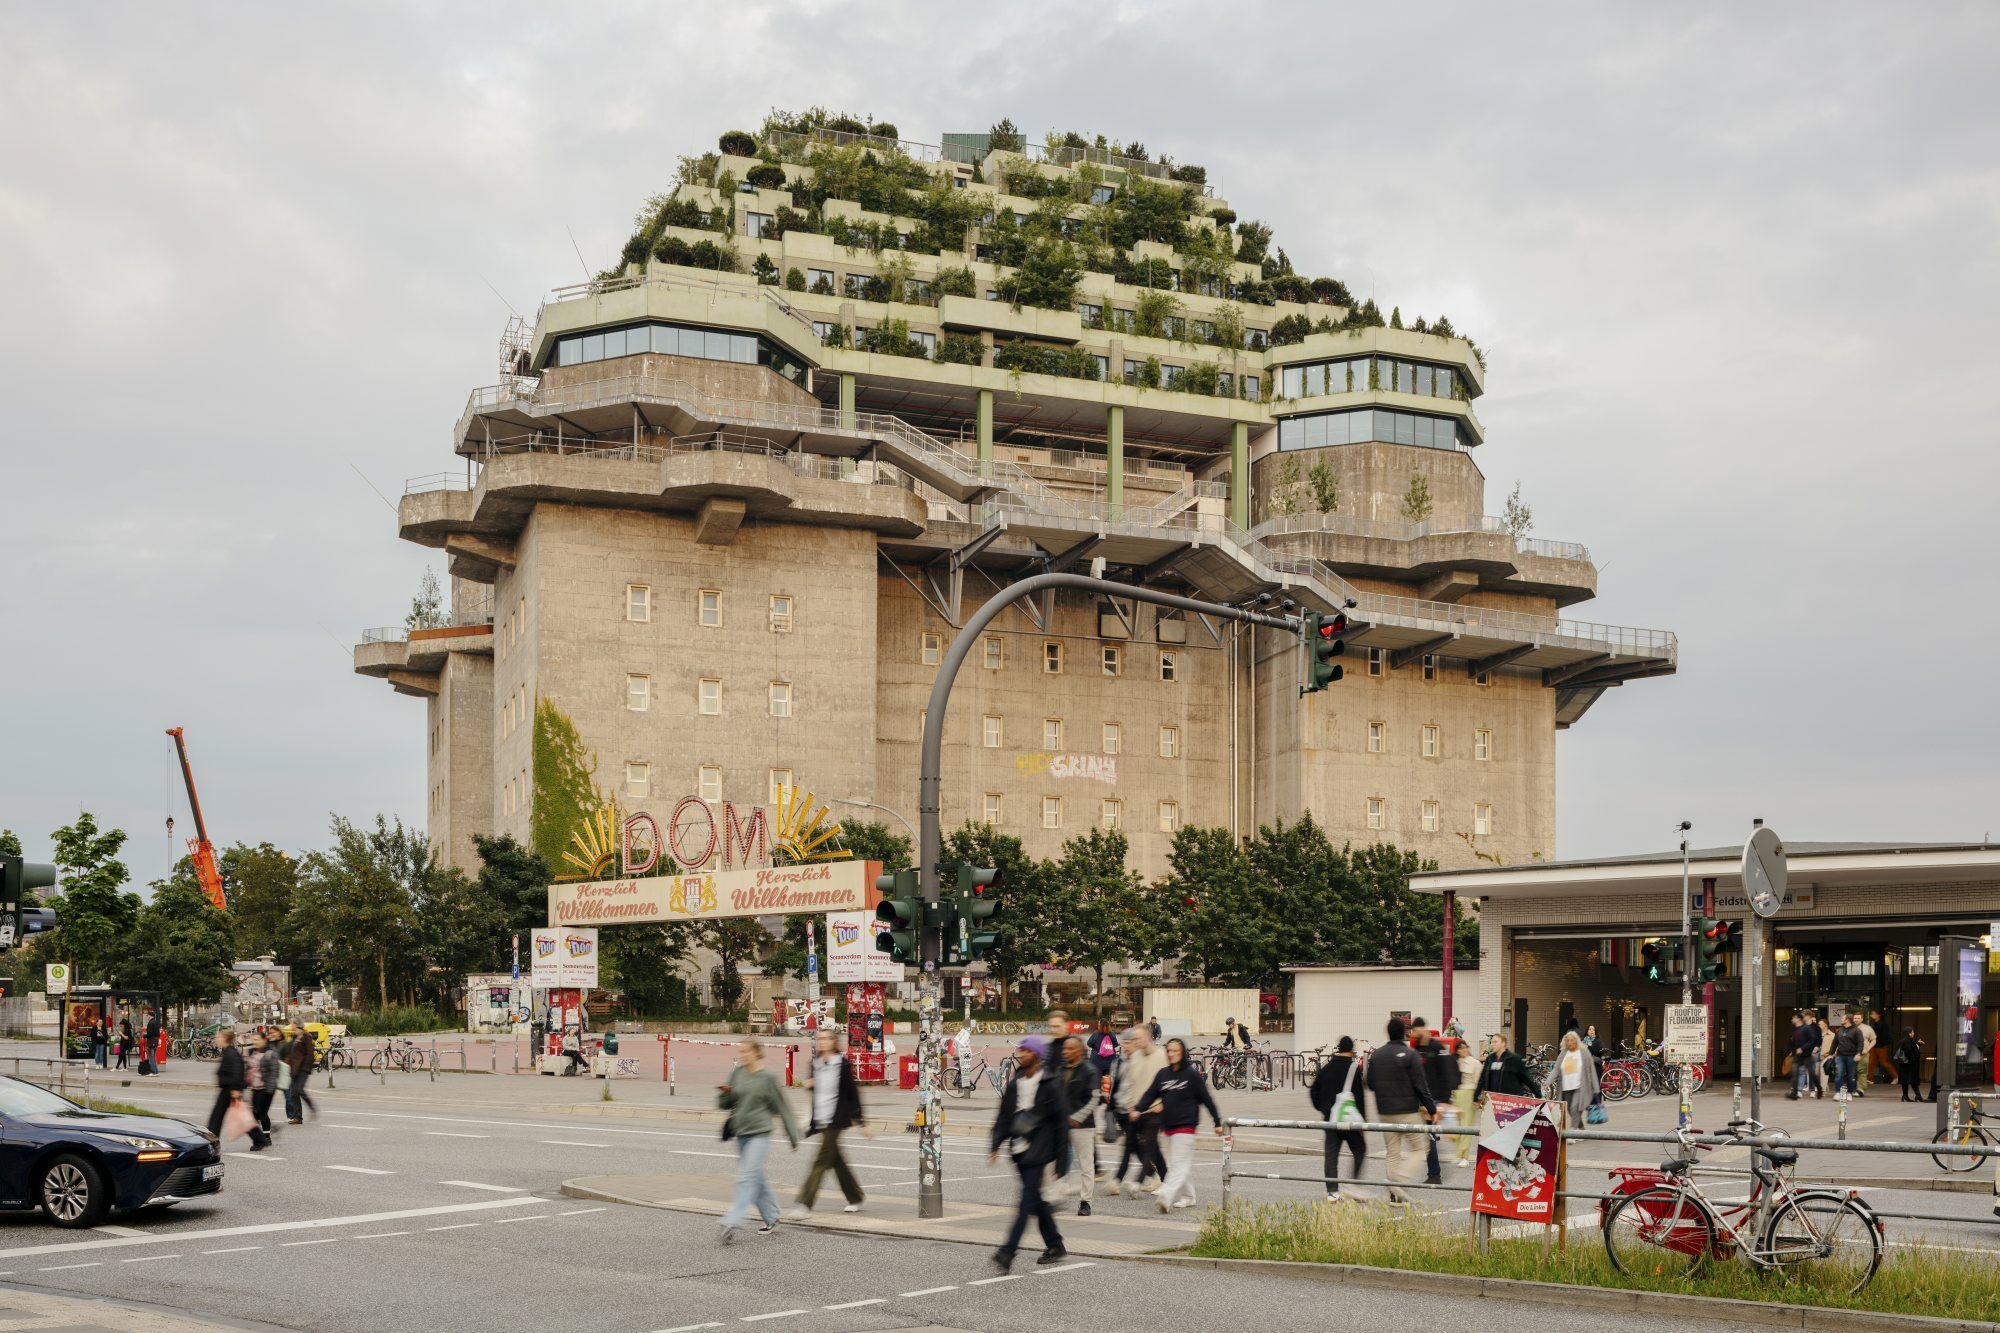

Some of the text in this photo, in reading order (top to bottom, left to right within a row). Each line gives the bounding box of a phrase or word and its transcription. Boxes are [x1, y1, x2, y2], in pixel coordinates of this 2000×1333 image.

[623, 795, 765, 874] DOM
[757, 865, 831, 887] Herzlich
[577, 881, 638, 899] Herzlich
[731, 885, 855, 910] Willkommen
[556, 899, 658, 921] Willkommen
[1714, 897, 1747, 906] Feldstr
[1669, 1016, 1706, 1024] FLOHMARKT
[1675, 1008, 1702, 1016] ROOFTOP
[1532, 1119, 1553, 1127] ern-
